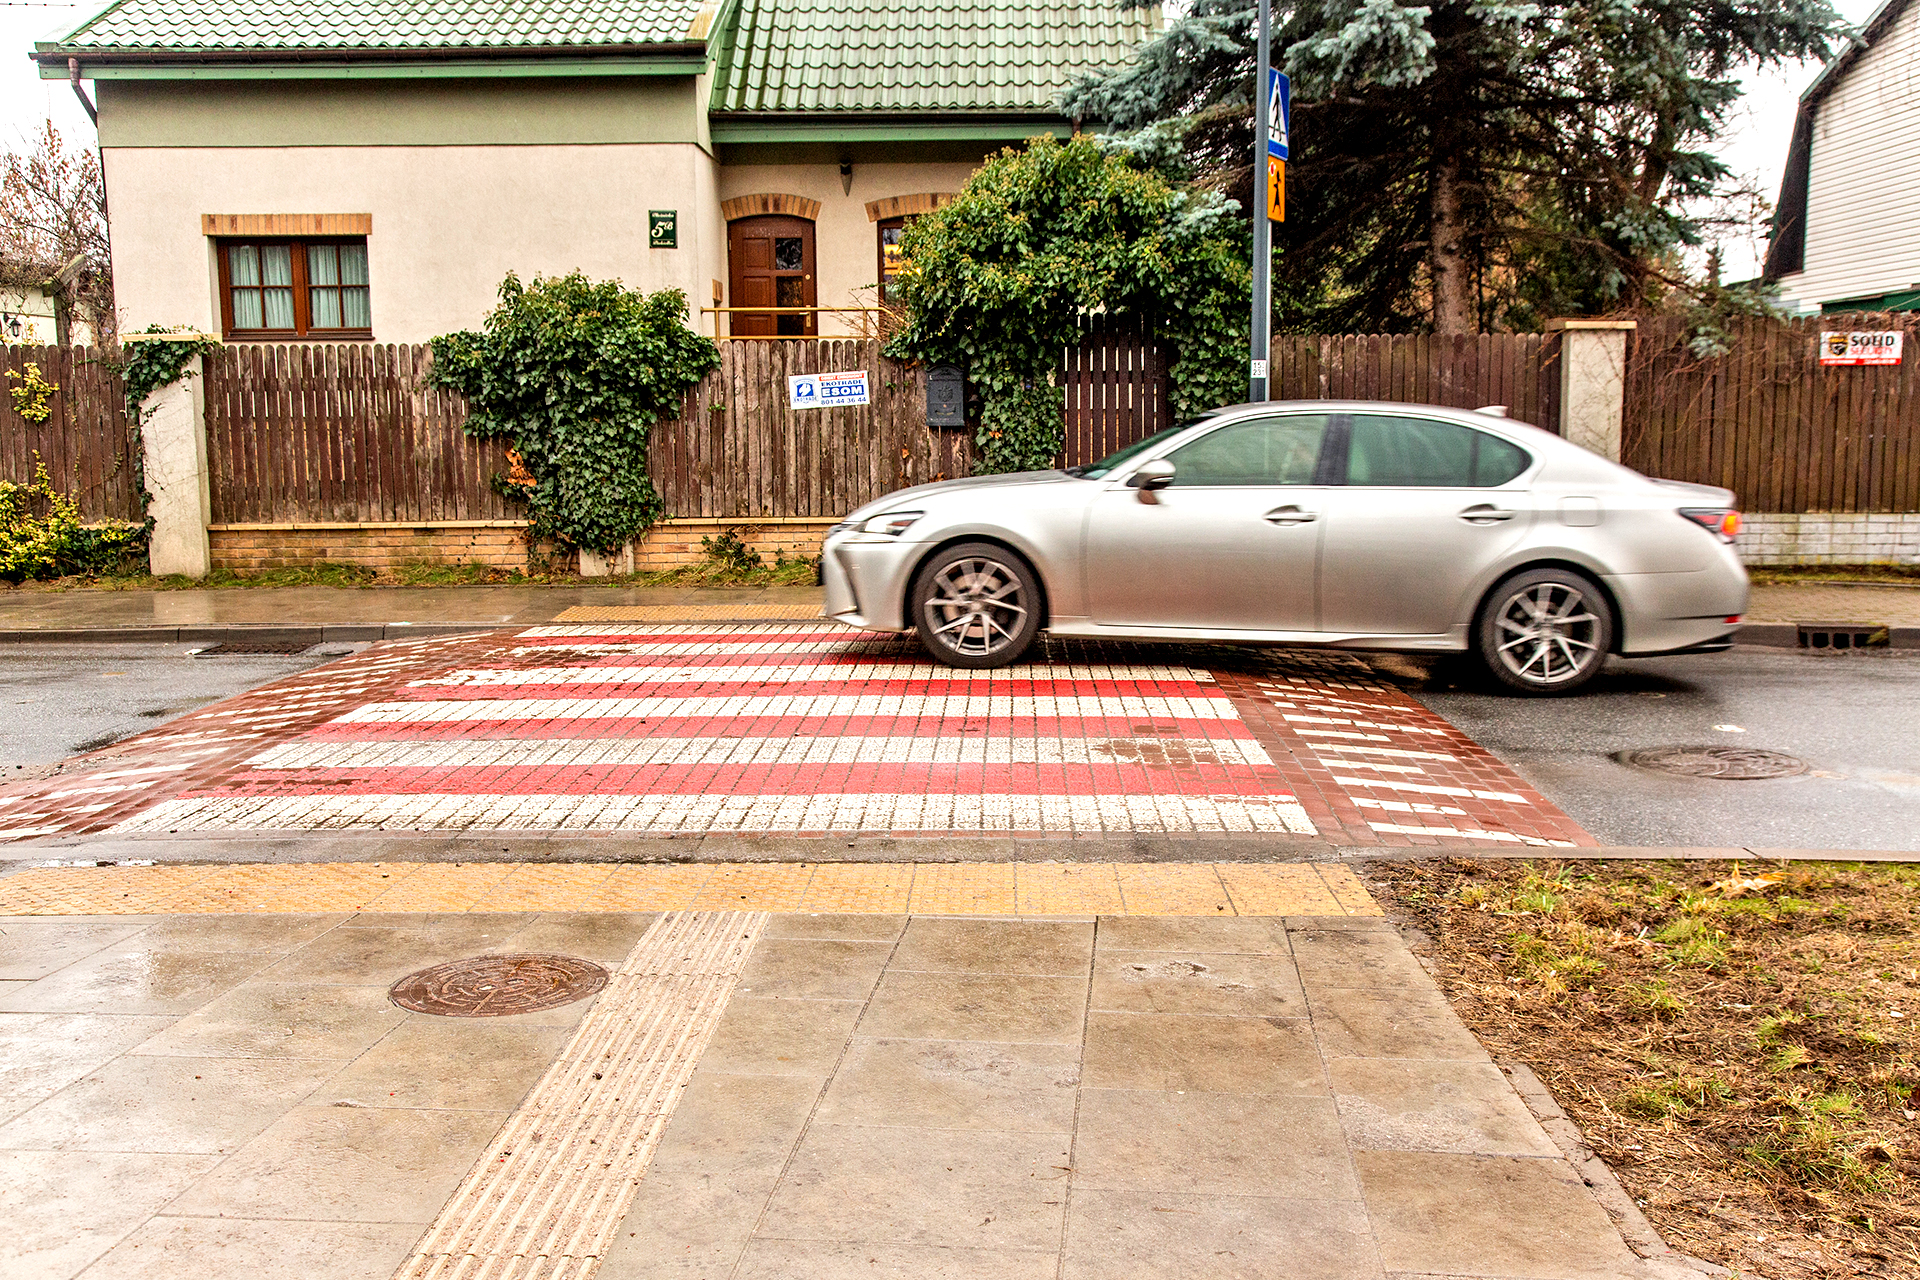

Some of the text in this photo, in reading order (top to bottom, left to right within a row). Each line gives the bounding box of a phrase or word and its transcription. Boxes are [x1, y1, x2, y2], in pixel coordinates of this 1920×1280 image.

[1851, 335, 1894, 346] SOLID
[821, 379, 862, 387] EKOTRADE
[822, 386, 862, 397] ESOM
